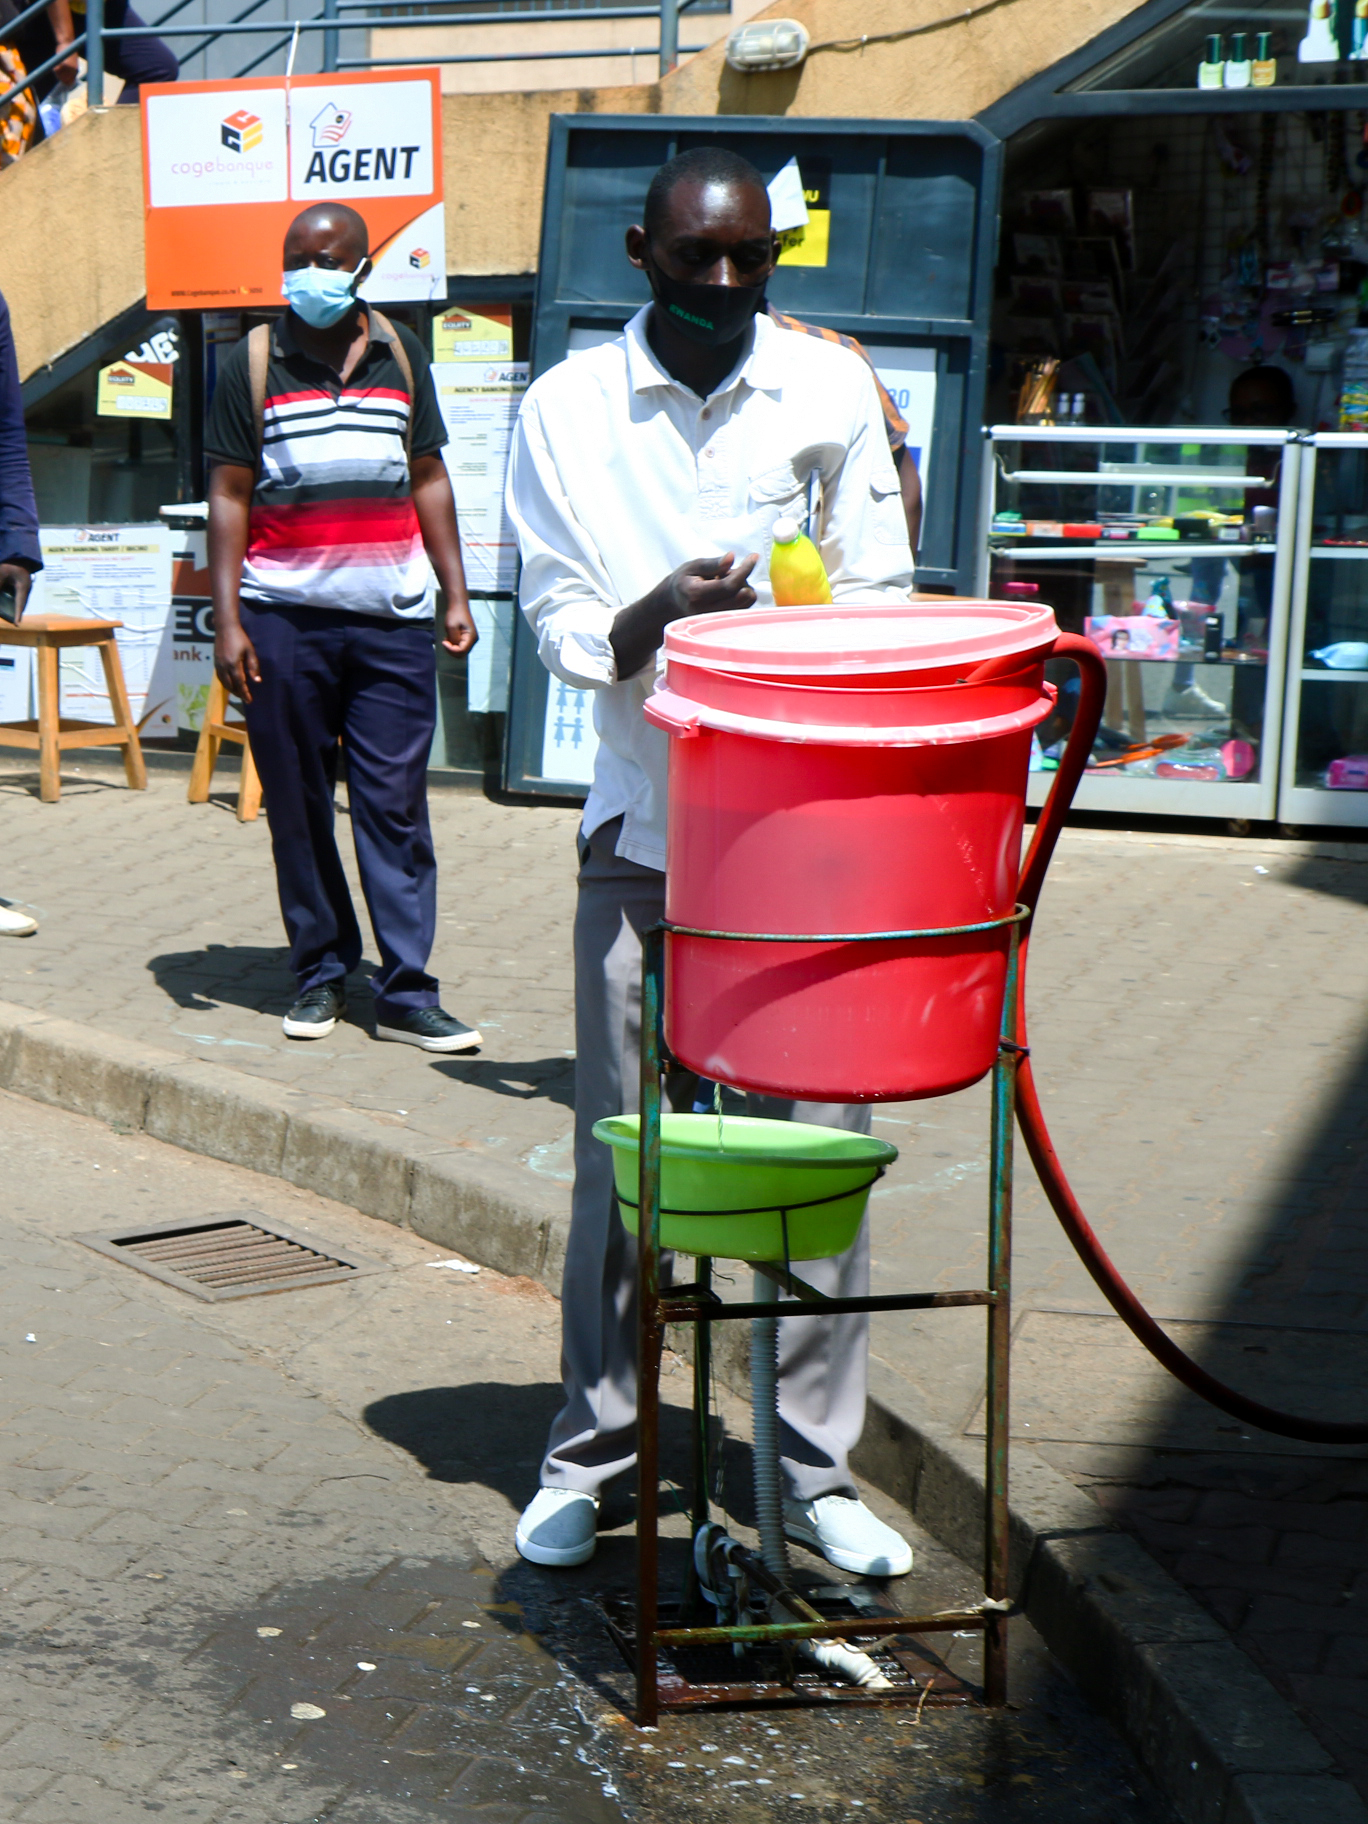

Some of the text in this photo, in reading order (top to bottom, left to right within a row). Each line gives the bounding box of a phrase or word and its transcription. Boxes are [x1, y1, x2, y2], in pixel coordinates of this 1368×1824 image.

[171, 156, 274, 178] cogebanque
[303, 146, 421, 184] AGENT
[669, 303, 715, 331] RWANDA
[88, 533, 121, 543] AGENT
